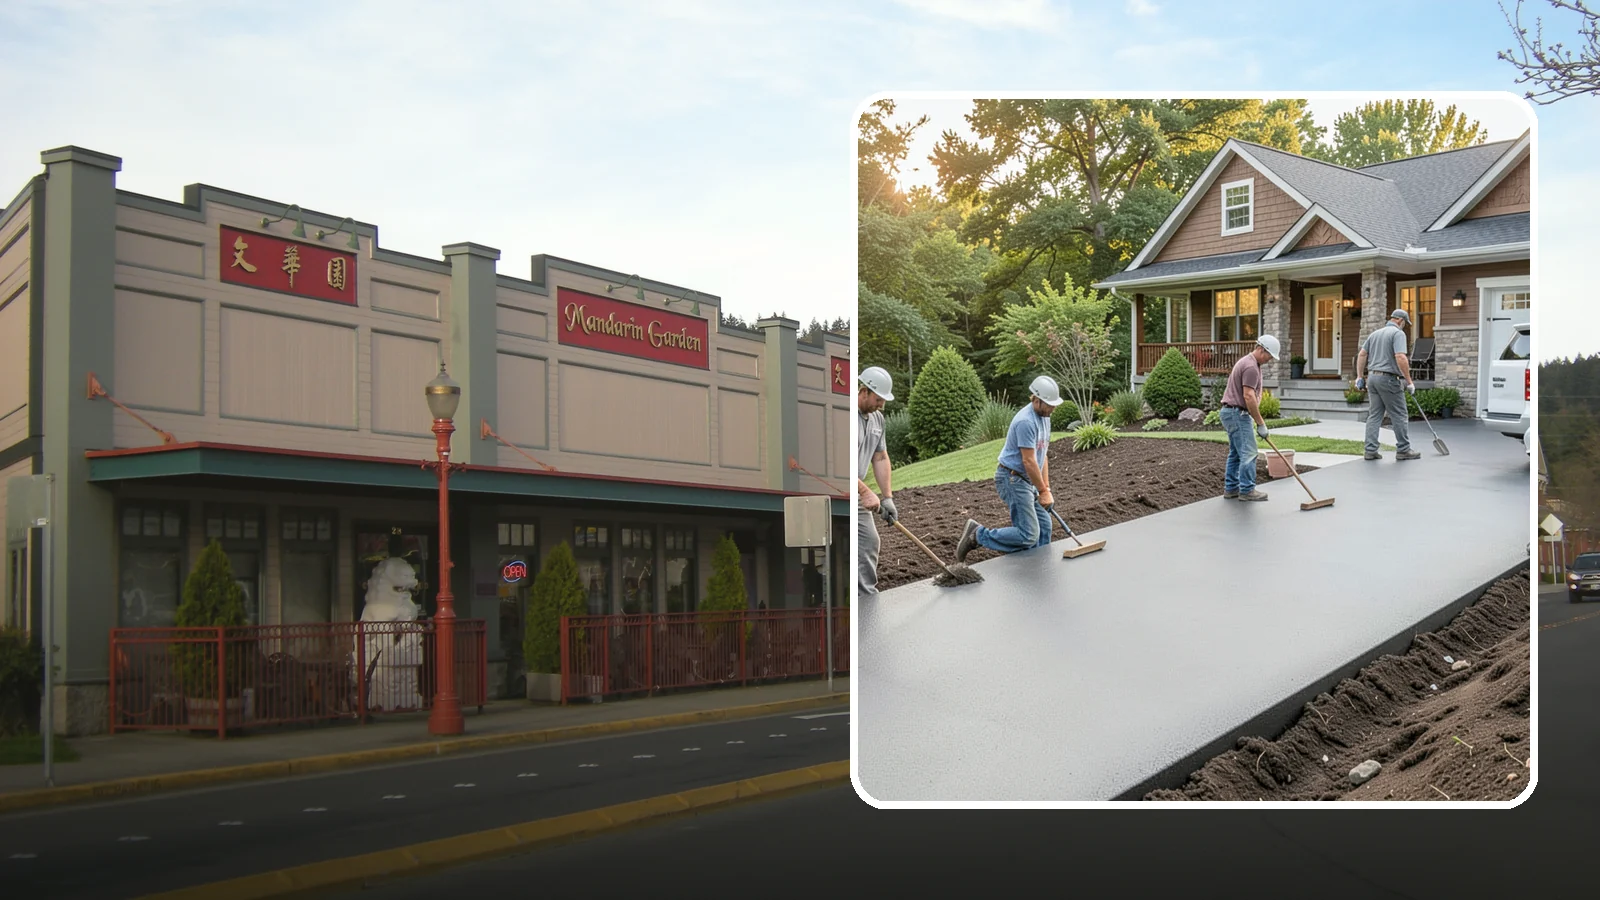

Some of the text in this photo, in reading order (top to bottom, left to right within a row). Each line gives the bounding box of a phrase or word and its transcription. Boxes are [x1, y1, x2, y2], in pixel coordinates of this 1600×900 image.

[230, 235, 346, 291] 文華園
[564, 302, 701, 352] Mandarin Garden
[503, 565, 527, 578] OPEN
